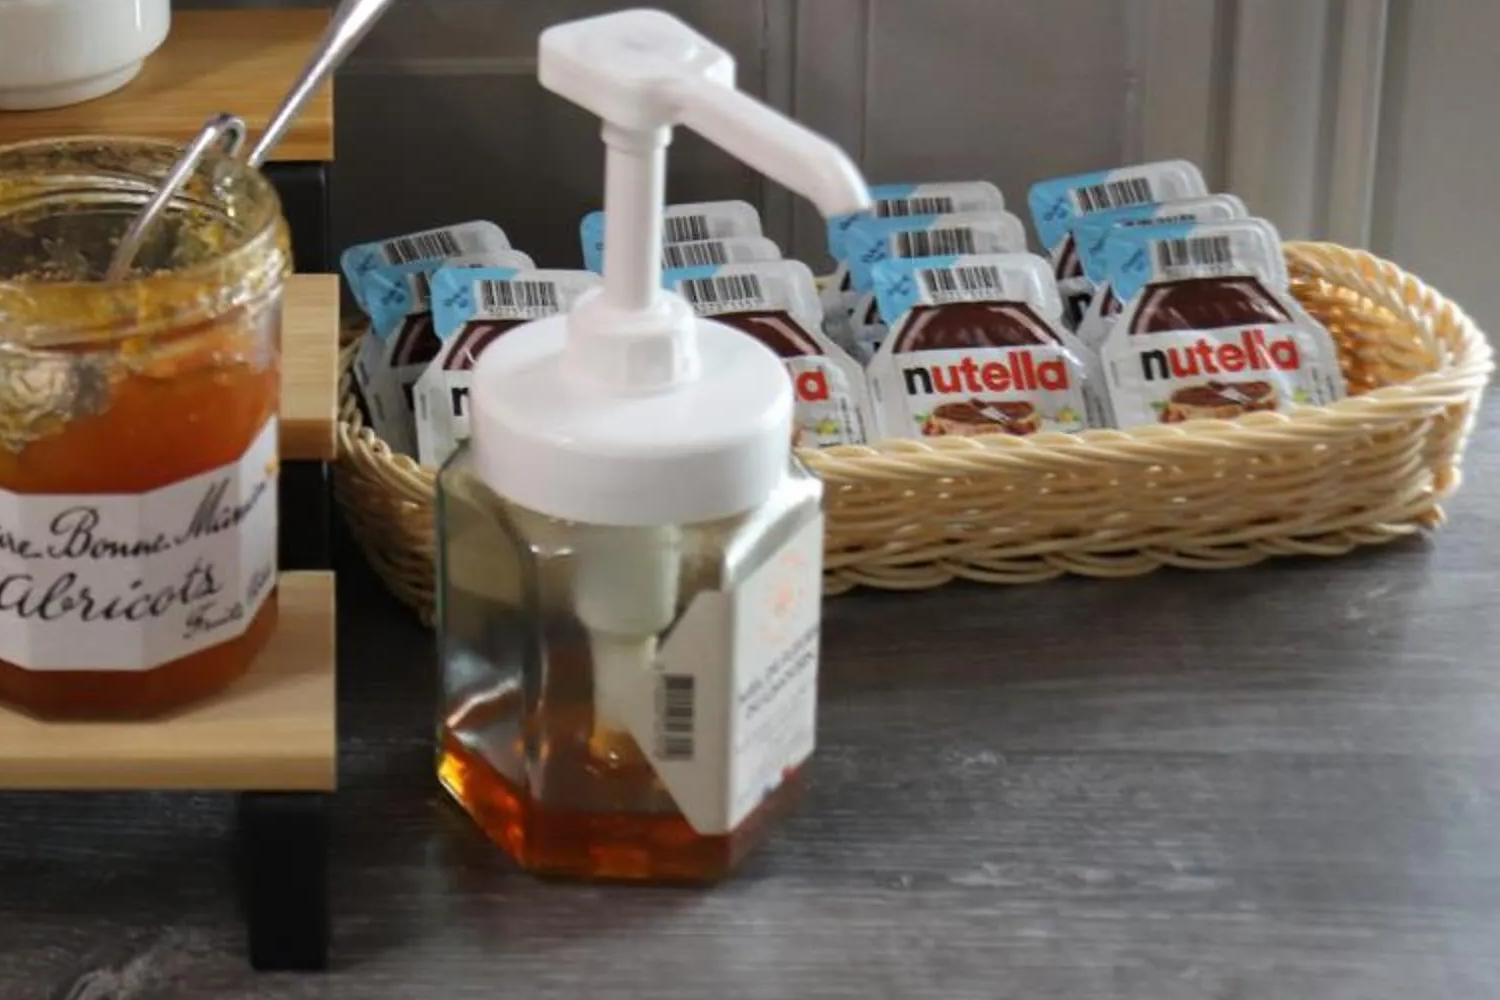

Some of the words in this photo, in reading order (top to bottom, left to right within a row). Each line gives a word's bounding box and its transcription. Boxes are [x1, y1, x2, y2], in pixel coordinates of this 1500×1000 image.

[902, 351, 1070, 395] nutella
[1140, 328, 1301, 381] nutella
[48, 506, 170, 559] Bonne
